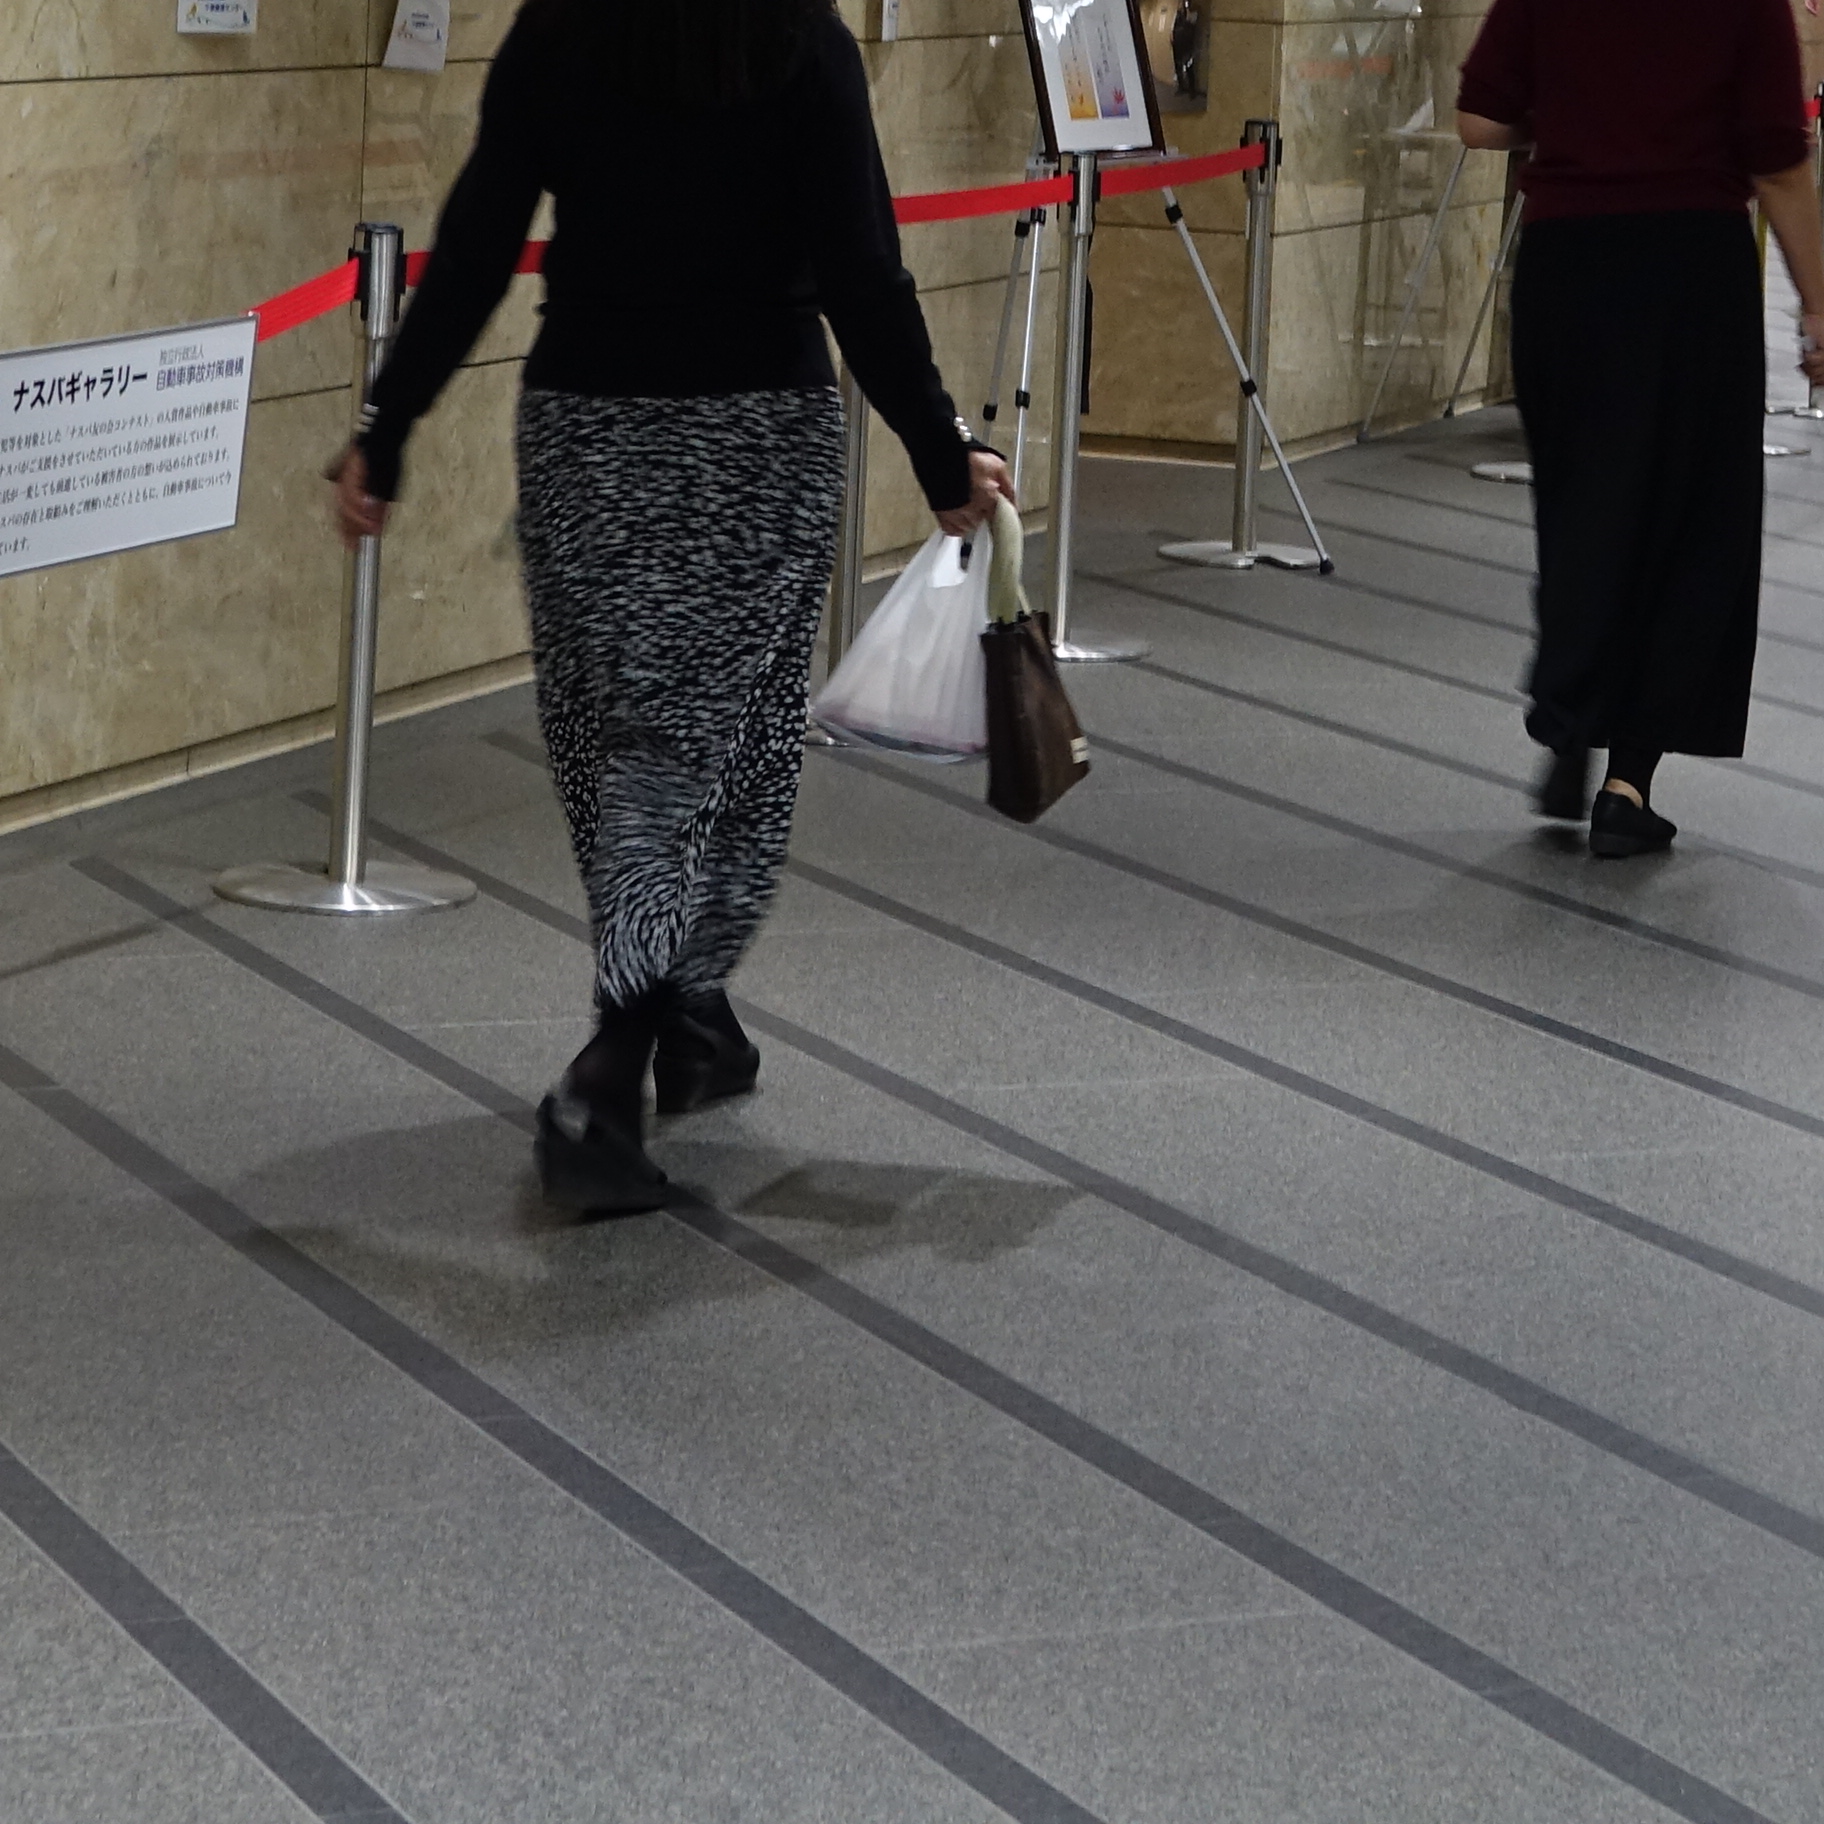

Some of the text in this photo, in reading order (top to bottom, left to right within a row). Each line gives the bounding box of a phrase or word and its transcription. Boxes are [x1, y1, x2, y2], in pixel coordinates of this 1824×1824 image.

[13, 364, 148, 413] ナスバギャラリー
